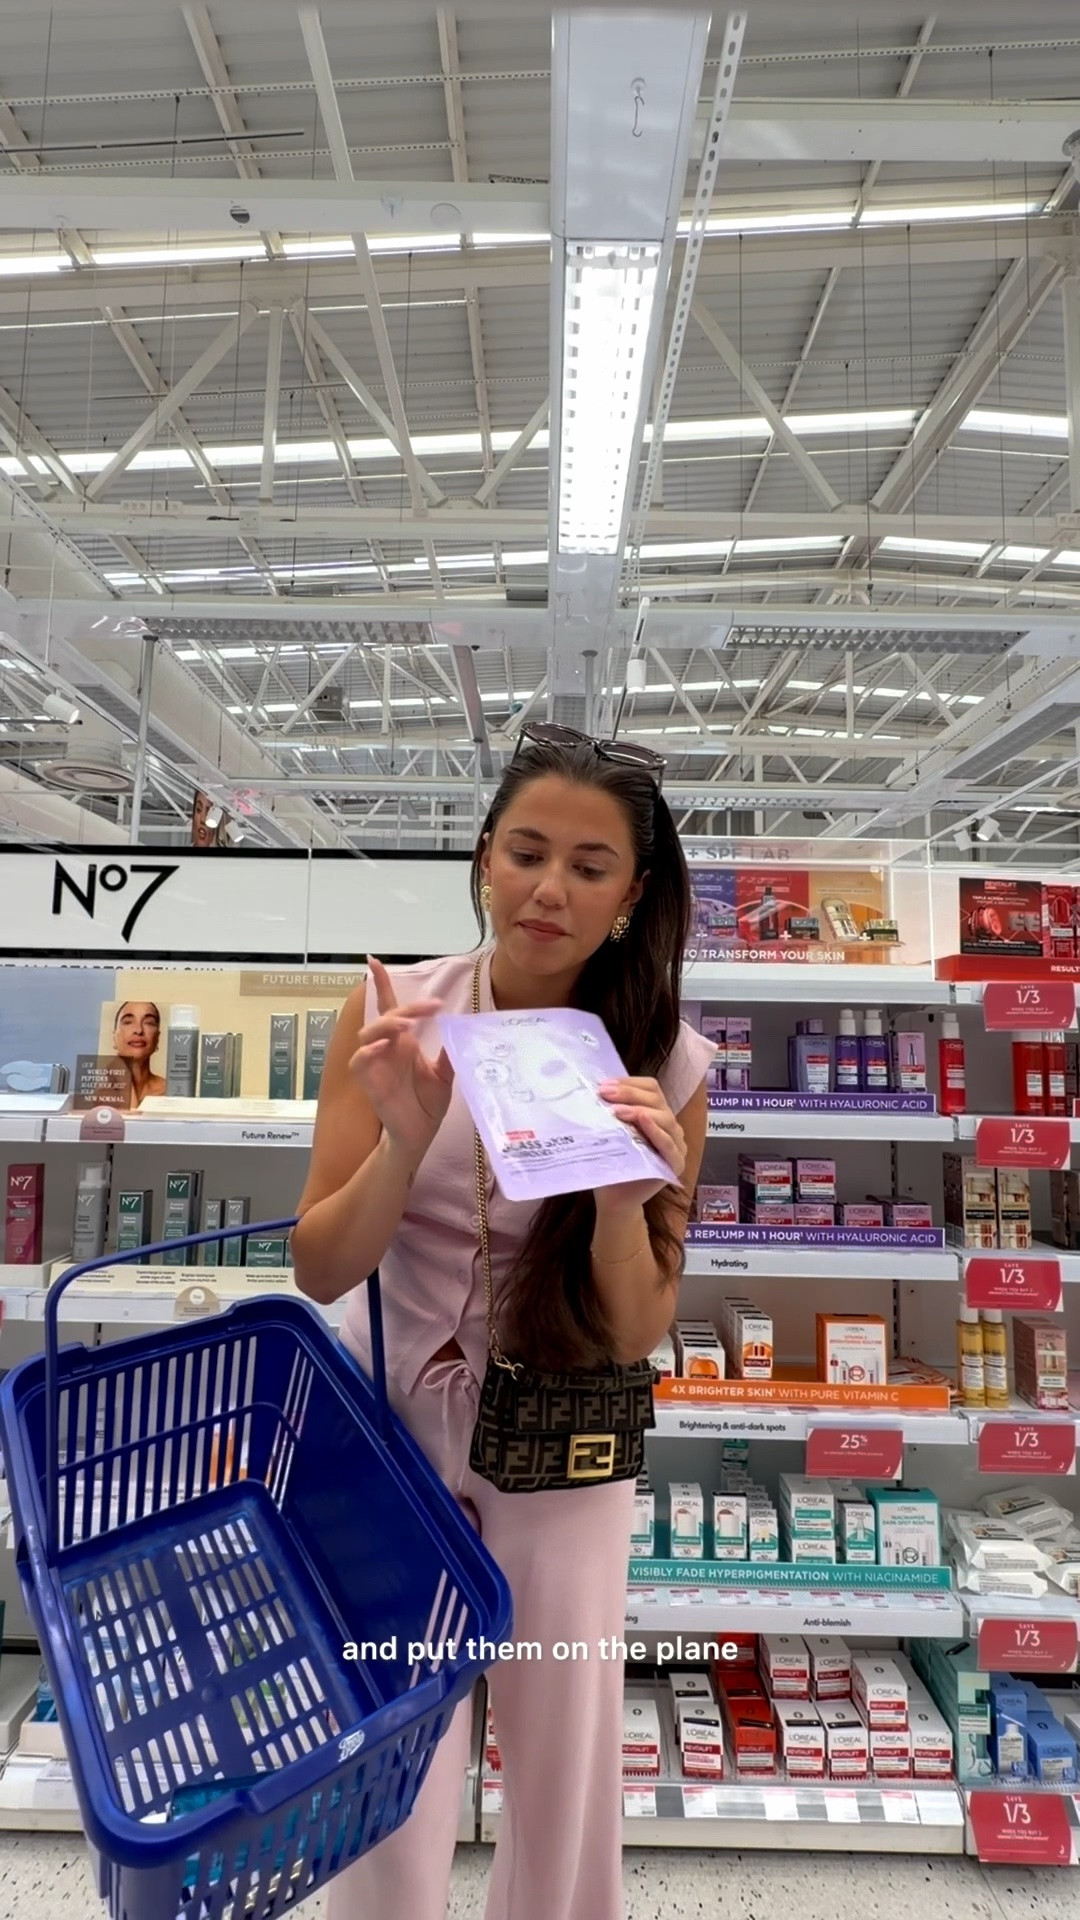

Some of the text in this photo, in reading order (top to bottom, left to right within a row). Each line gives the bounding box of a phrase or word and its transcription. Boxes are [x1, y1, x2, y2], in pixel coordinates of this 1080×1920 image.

[702, 950, 777, 960] TRANSFORM
[780, 950, 814, 961] YOUR
[818, 951, 845, 961] SKIN
[262, 974, 310, 985] FUTURE
[1016, 990, 1041, 1004] 1/3
[741, 1098, 753, 1107] IN
[756, 1098, 761, 1107] 1
[800, 1099, 827, 1108] WITH
[830, 1100, 899, 1109] HYALURONIC
[902, 1101, 927, 1110] ACID
[709, 1122, 745, 1131] Hydrating
[241, 1131, 266, 1140] Future
[1010, 1128, 1035, 1143] 1/3
[694, 1230, 745, 1240] REPLUMP
[748, 1231, 760, 1240] IN
[762, 1231, 766, 1240] 1
[806, 1232, 834, 1242] WITH
[837, 1233, 907, 1243] HYALURONIC
[910, 1234, 937, 1244] ACID
[711, 1259, 748, 1269] Hydrating
[1000, 1269, 1025, 1284] 1/3
[671, 1386, 686, 1395] 4X
[688, 1387, 744, 1396] BRIGHTER
[779, 1389, 808, 1399] WITH
[811, 1390, 840, 1400] PURE
[844, 1391, 889, 1401] VITAMIN
[891, 1392, 899, 1401] C
[679, 1421, 786, 1432] Brightening & anti-dark spots
[1014, 1432, 1039, 1447] 1/3
[631, 1567, 938, 1584] VISIBLY FADE HYPERPIGMENTATION WITH NIACINAMIDE
[803, 1618, 852, 1628] Anti-blemish
[1015, 1630, 1040, 1647] 1/3
[1003, 1803, 1031, 1824] 1/3
